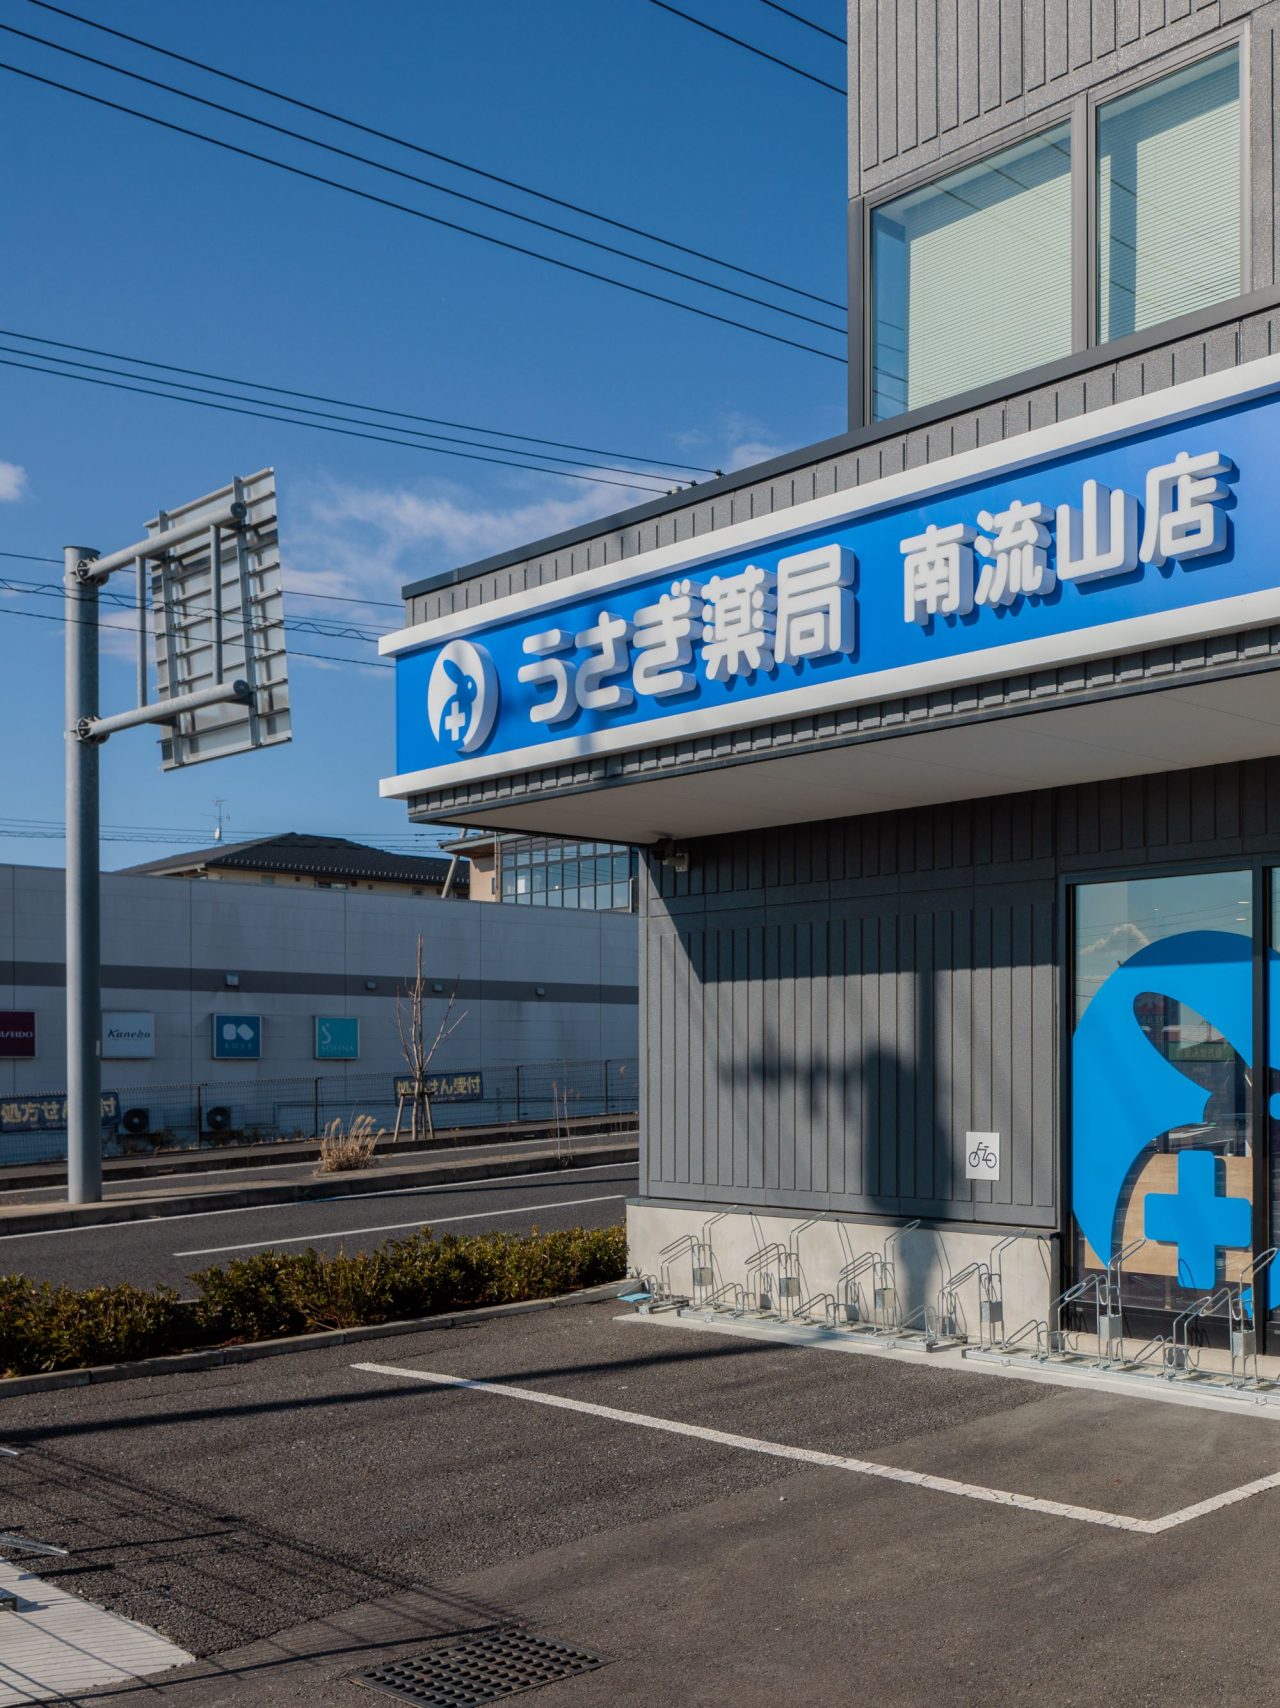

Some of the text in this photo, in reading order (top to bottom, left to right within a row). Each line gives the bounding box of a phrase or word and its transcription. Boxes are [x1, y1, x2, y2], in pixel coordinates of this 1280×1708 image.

[517, 450, 1234, 724] うさぎ薬局 南流山店
[107, 1029, 151, 1038] Kanebo
[396, 1076, 480, 1097] 処せん受付
[1, 1097, 116, 1123] 処方せ付
